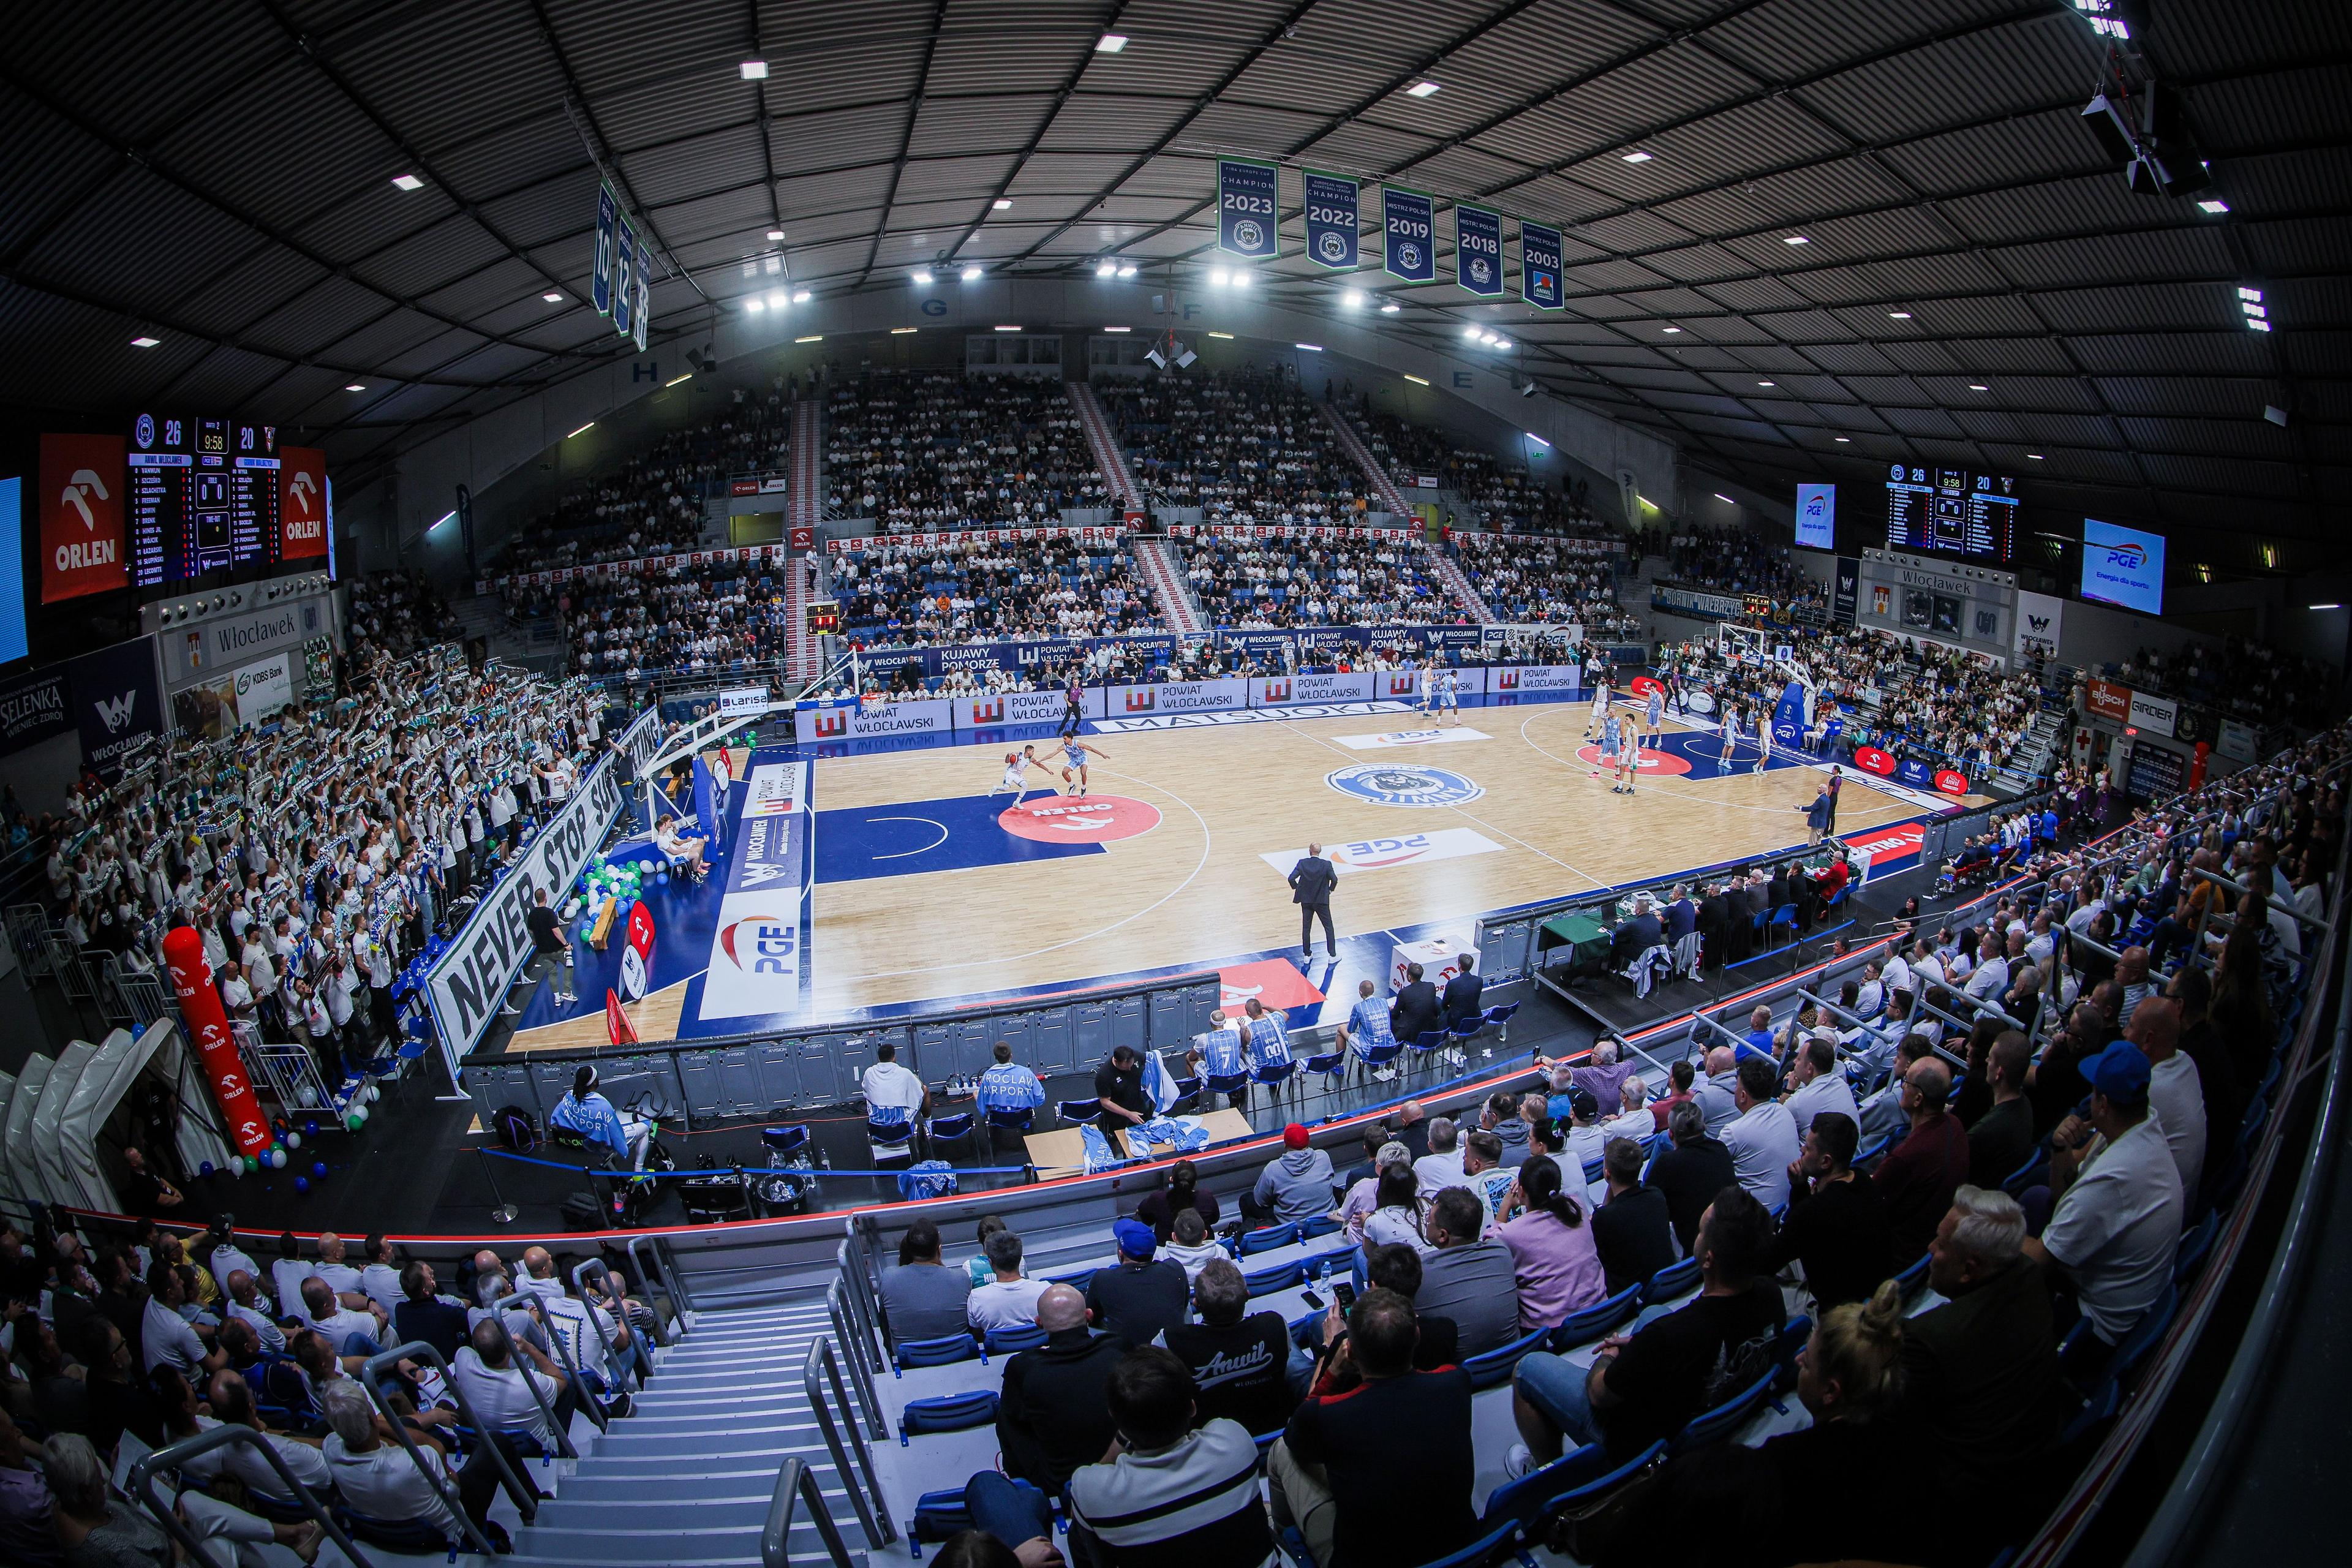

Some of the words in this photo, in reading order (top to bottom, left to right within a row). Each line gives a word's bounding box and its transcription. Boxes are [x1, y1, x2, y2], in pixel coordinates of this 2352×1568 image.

[1222, 176, 1274, 189] CHAMPION
[1308, 189, 1356, 203] CHAMPION
[1224, 194, 1273, 214] 2023
[1387, 203, 1408, 212] MISTRZ
[1409, 206, 1430, 216] POLSKI
[1310, 206, 1355, 227] 2022
[1240, 222, 1259, 232] ANWIL
[1389, 217, 1429, 238] 2019
[1460, 218, 1479, 228] MISTRZ
[1479, 224, 1498, 232] POLSKI
[1325, 235, 1342, 244] ANWIL
[1461, 233, 1498, 254] 2018
[1524, 234, 1542, 243] MISTRZ
[1542, 239, 1559, 248] POLSKI
[597, 228, 610, 282] 10
[1401, 243, 1419, 254] ANWIL
[1526, 249, 1559, 269] 2003
[618, 256, 630, 306] 12
[1536, 287, 1552, 296] ANWIL
[921, 298, 948, 316] G
[1183, 304, 1202, 320] F
[633, 362, 658, 382] H
[1453, 371, 1473, 388] E
[166, 420, 182, 445] 26
[241, 427, 254, 450] 20
[205, 435, 222, 450] 9:58
[1912, 468, 1924, 481] 26
[1943, 478, 1960, 488] 9:58
[1977, 476, 1990, 490] 20
[202, 484, 206, 500] 0
[217, 484, 222, 500] 0
[1806, 505, 1822, 516] PGE
[1940, 503, 1945, 513] 0
[1954, 505, 1959, 514] 0
[287, 521, 320, 541] ORLEN
[56, 539, 115, 571] ORLEN
[2107, 551, 2139, 570] PGE
[1902, 570, 1970, 594] Włocławek
[2097, 571, 2119, 582] Energia
[2130, 579, 2149, 589] sportu
[1666, 589, 1695, 609] GÓRNIK
[218, 613, 295, 652] Włocławek
[1316, 632, 1342, 641] POWIAT
[1371, 629, 1408, 639] KUJAWY
[2021, 633, 2054, 646] WŁOCŁAWEK
[941, 647, 990, 661] KUJAWY
[1041, 645, 1071, 654] POWIAT
[941, 658, 1000, 672] POMORZE
[252, 671, 269, 685] KDBS
[270, 665, 283, 679] Bank
[1298, 677, 1335, 688] POWIAT
[239, 680, 249, 688] SGB
[1163, 684, 1203, 696] POWIAT
[1524, 678, 1570, 688] WŁOCŁAWSKI
[1012, 695, 1055, 708] POWIAT
[1298, 687, 1360, 701] WŁOCŁAWSKI
[2092, 690, 2125, 707] BUSCH
[0, 685, 64, 730] SELENKA
[1163, 695, 1232, 709] WŁOCŁAWSKI
[854, 707, 899, 721] POWIAT
[1012, 705, 1088, 720] WŁOCŁAWKI
[1115, 702, 1397, 730] MATSUOKA
[2132, 701, 2173, 722] GIRDER
[854, 717, 934, 734] WŁOCŁAWSKI
[1388, 729, 1443, 740] PGE
[1776, 728, 1792, 739] PGE
[779, 764, 797, 797] WŁOCŁAWSKI
[1844, 775, 1901, 794] PGE
[1943, 774, 1960, 787] Anwil
[758, 779, 775, 799] POWIAT
[1382, 786, 1468, 804] ANWIL
[1032, 803, 1114, 816] ORLEN
[746, 820, 768, 861] WŁOCŁAWEK
[1346, 835, 1431, 856] PGE
[447, 872, 536, 1041] NEVER
[544, 803, 587, 894] STOP
[755, 926, 795, 974] PGE
[205, 1038, 225, 1051] ORLEN
[1264, 1043, 1282, 1059] 00
[1221, 1054, 1230, 1069] 7
[224, 1086, 245, 1100] ORLEN
[983, 1085, 1033, 1097] AIRPORT
[244, 1133, 265, 1147] ORLEN
[1194, 1340, 1274, 1381] Anwil
